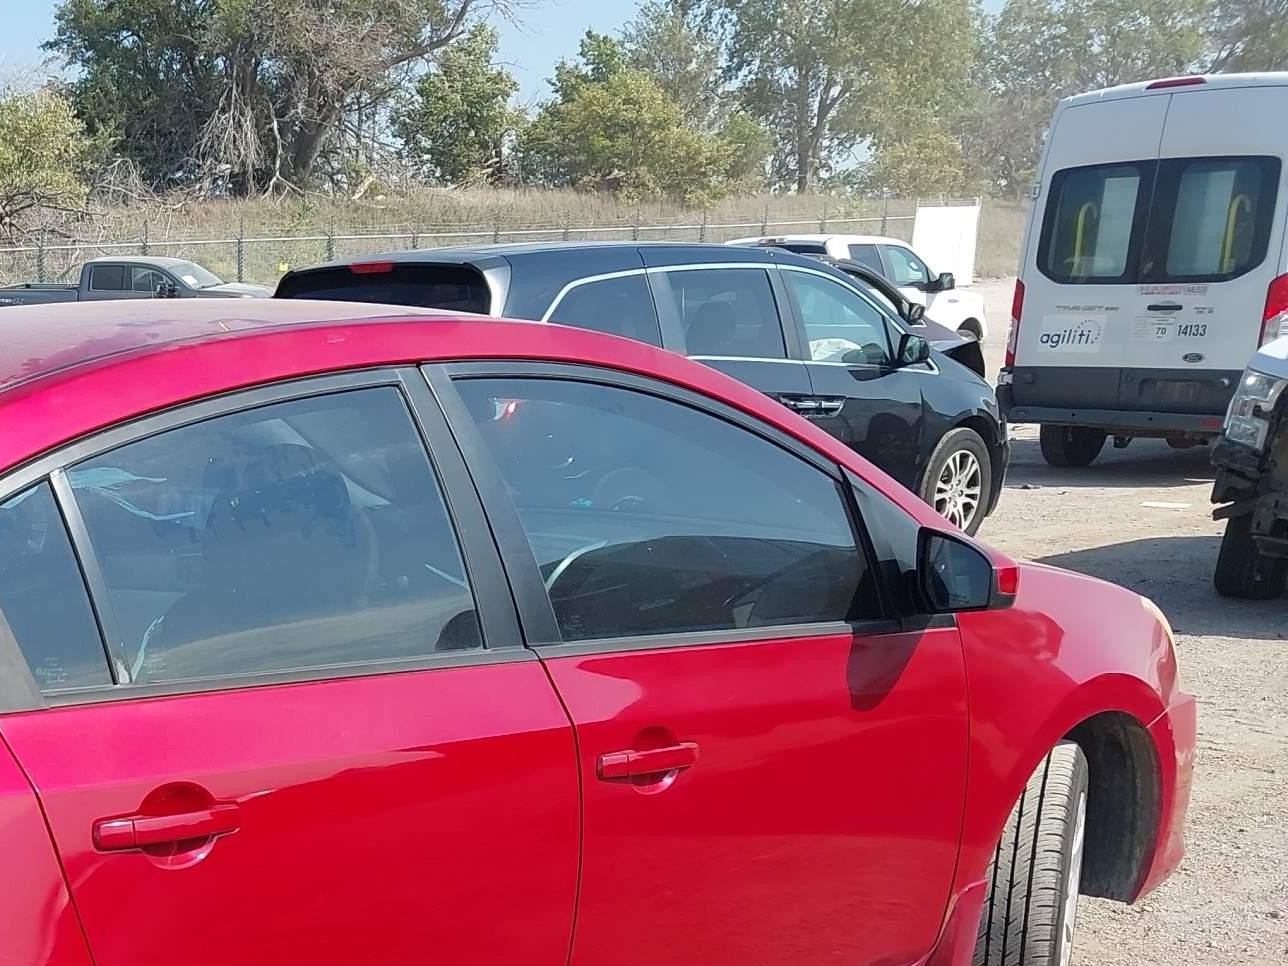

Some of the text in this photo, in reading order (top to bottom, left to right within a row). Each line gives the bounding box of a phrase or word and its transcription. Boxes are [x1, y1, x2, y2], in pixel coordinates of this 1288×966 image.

[1155, 327, 1167, 335] 70
[1178, 324, 1207, 337] 14133
[1040, 329, 1092, 348] agiliti
